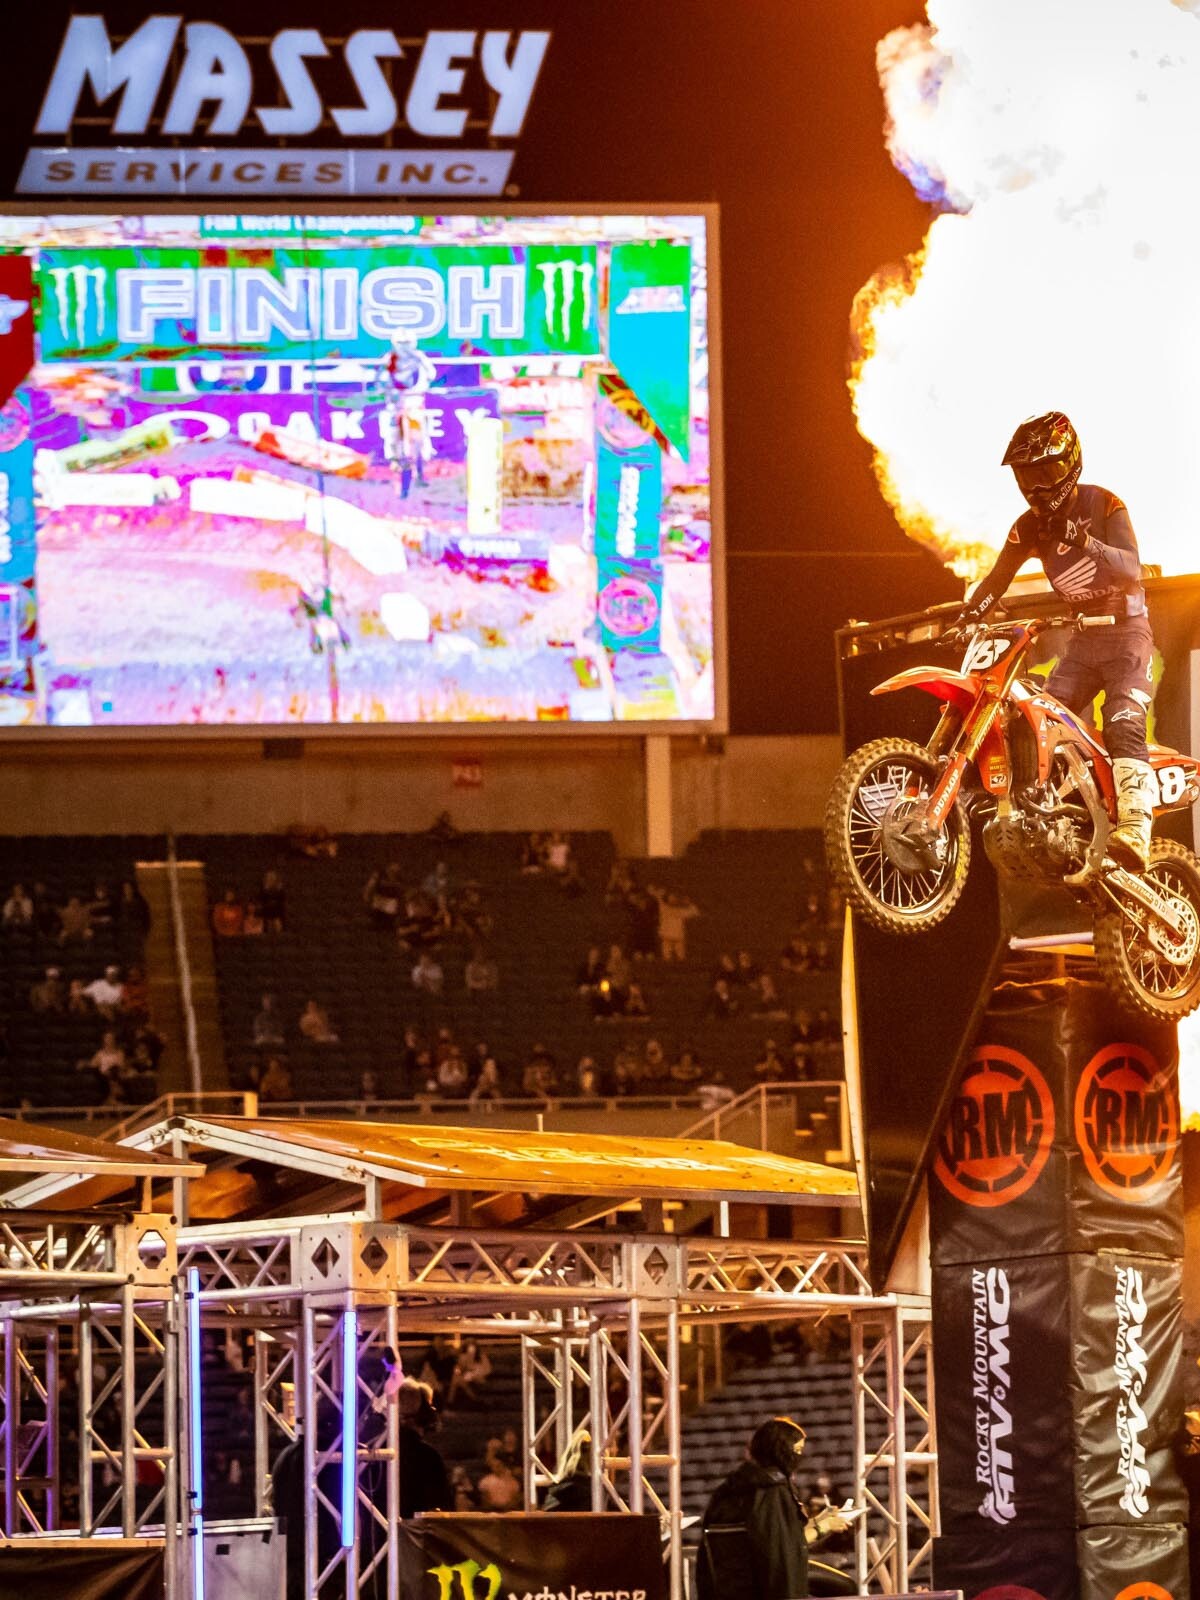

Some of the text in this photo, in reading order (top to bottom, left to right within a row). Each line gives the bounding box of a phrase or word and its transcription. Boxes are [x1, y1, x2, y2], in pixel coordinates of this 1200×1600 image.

[33, 15, 552, 137] MASSEY
[44, 160, 490, 185] SERVICES INC.
[116, 265, 526, 342] FINISH
[960, 632, 1011, 677] 18
[933, 768, 960, 816] DUNLOP
[950, 1090, 1028, 1163] RM
[1099, 1087, 1163, 1155] RM
[972, 1268, 993, 1487] ROCKY MOUNTAIN
[1114, 1265, 1134, 1479] ROCKY MOUNTAIN
